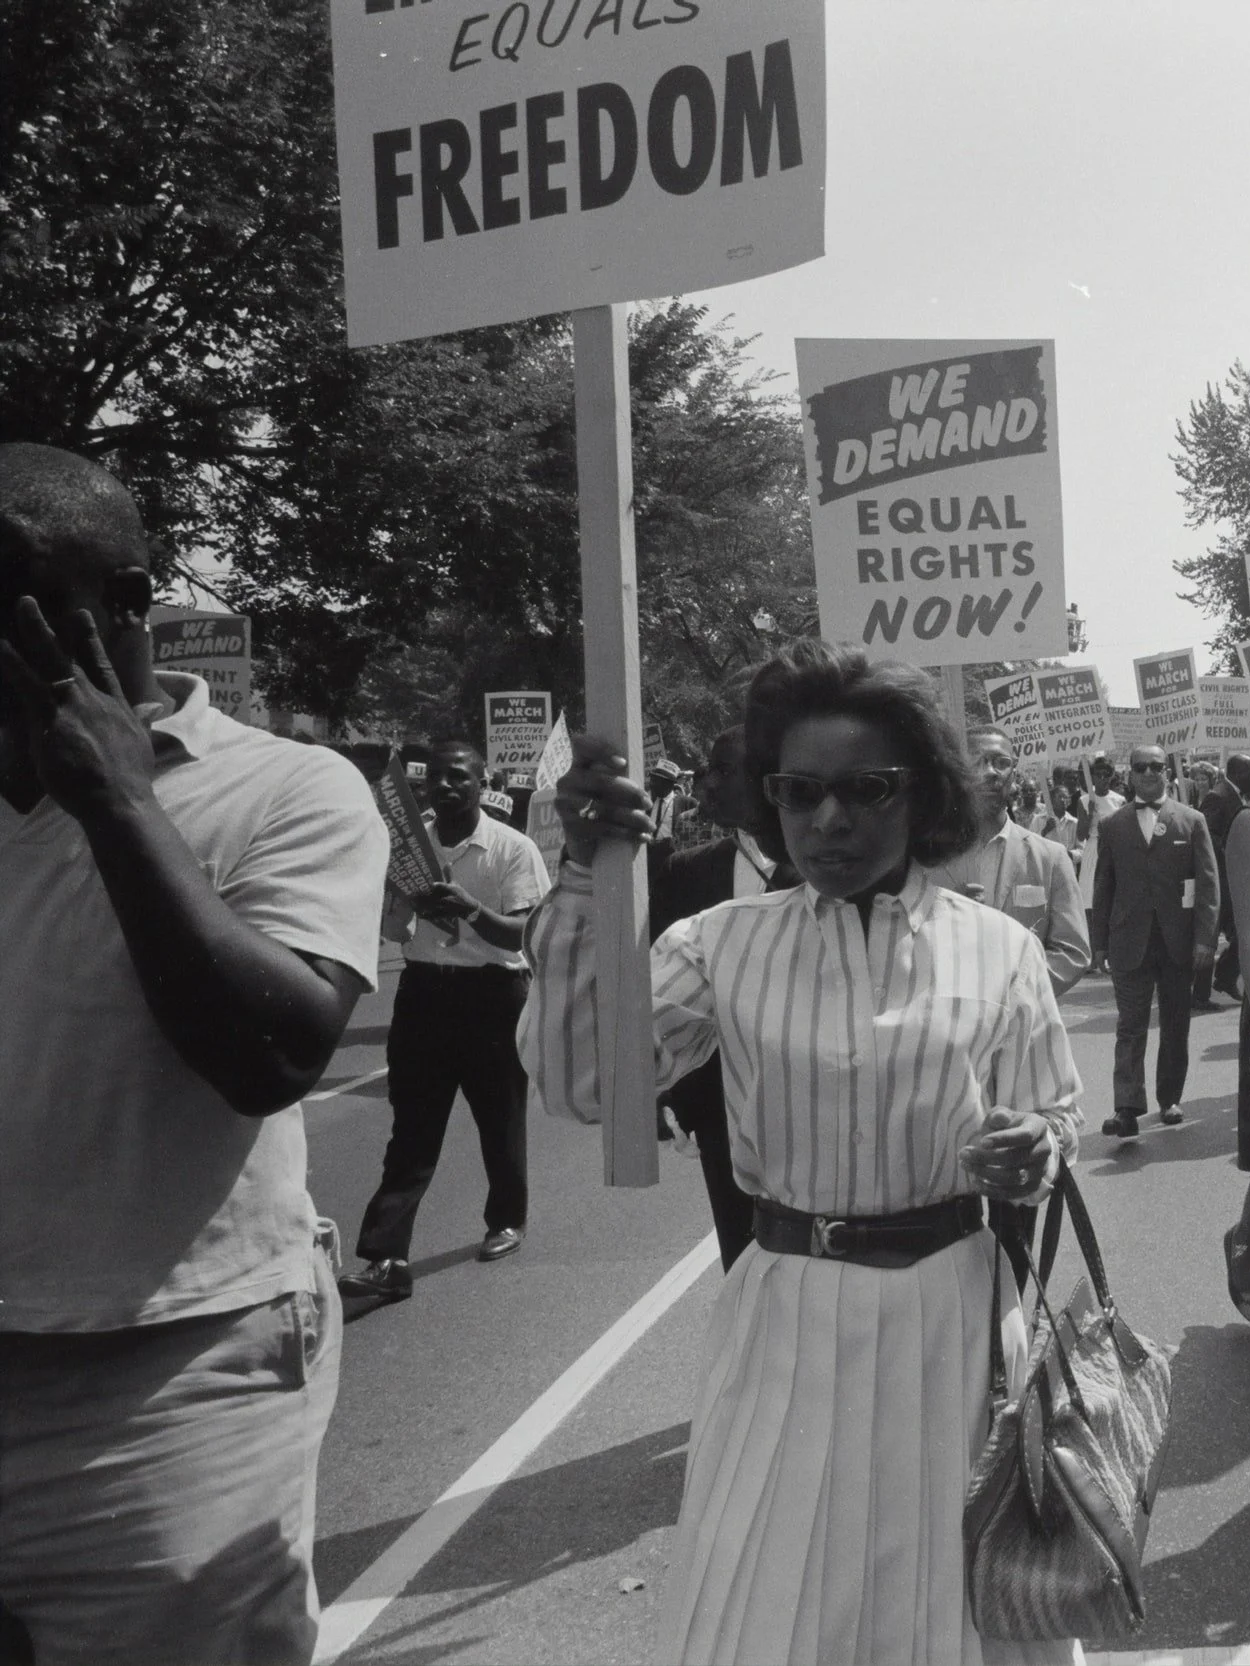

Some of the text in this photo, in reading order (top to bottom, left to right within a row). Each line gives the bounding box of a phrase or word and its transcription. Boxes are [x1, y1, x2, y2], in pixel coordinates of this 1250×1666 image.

[372, 38, 803, 250] FREEDOM
[889, 363, 971, 421] WE
[833, 397, 1038, 485] DEMAND
[856, 494, 1027, 535] EQUAL
[857, 541, 1036, 584] RIGHTS
[862, 581, 1043, 645] NOW!
[182, 621, 217, 639] WE
[160, 636, 242, 659] DEMAND
[167, 666, 238, 684] ENT
[1159, 661, 1173, 672] WE
[1009, 678, 1030, 698] WE
[1058, 675, 1076, 686] WE
[1146, 668, 1189, 690] MARCH
[1045, 682, 1093, 700] MARCH
[494, 707, 542, 718] MARCH
[509, 699, 527, 707] WE
[998, 690, 1037, 717] DEMA
[1045, 703, 1101, 723] INTEGRATED
[1145, 701, 1169, 716] FIRST
[1172, 694, 1197, 709] CLASS
[1004, 712, 1040, 727] AN EN
[1048, 717, 1104, 736] SCHOOLS
[1145, 706, 1200, 729] CITIZENSHIP
[489, 735, 512, 743] CIVIL
[1010, 732, 1044, 746] RUTALIT
[1056, 730, 1104, 752] NOW!
[1156, 722, 1198, 748] NOW!
[1205, 726, 1249, 739] REEDOM
[380, 774, 409, 827] MARCH
[406, 834, 434, 885] WASHINGT
